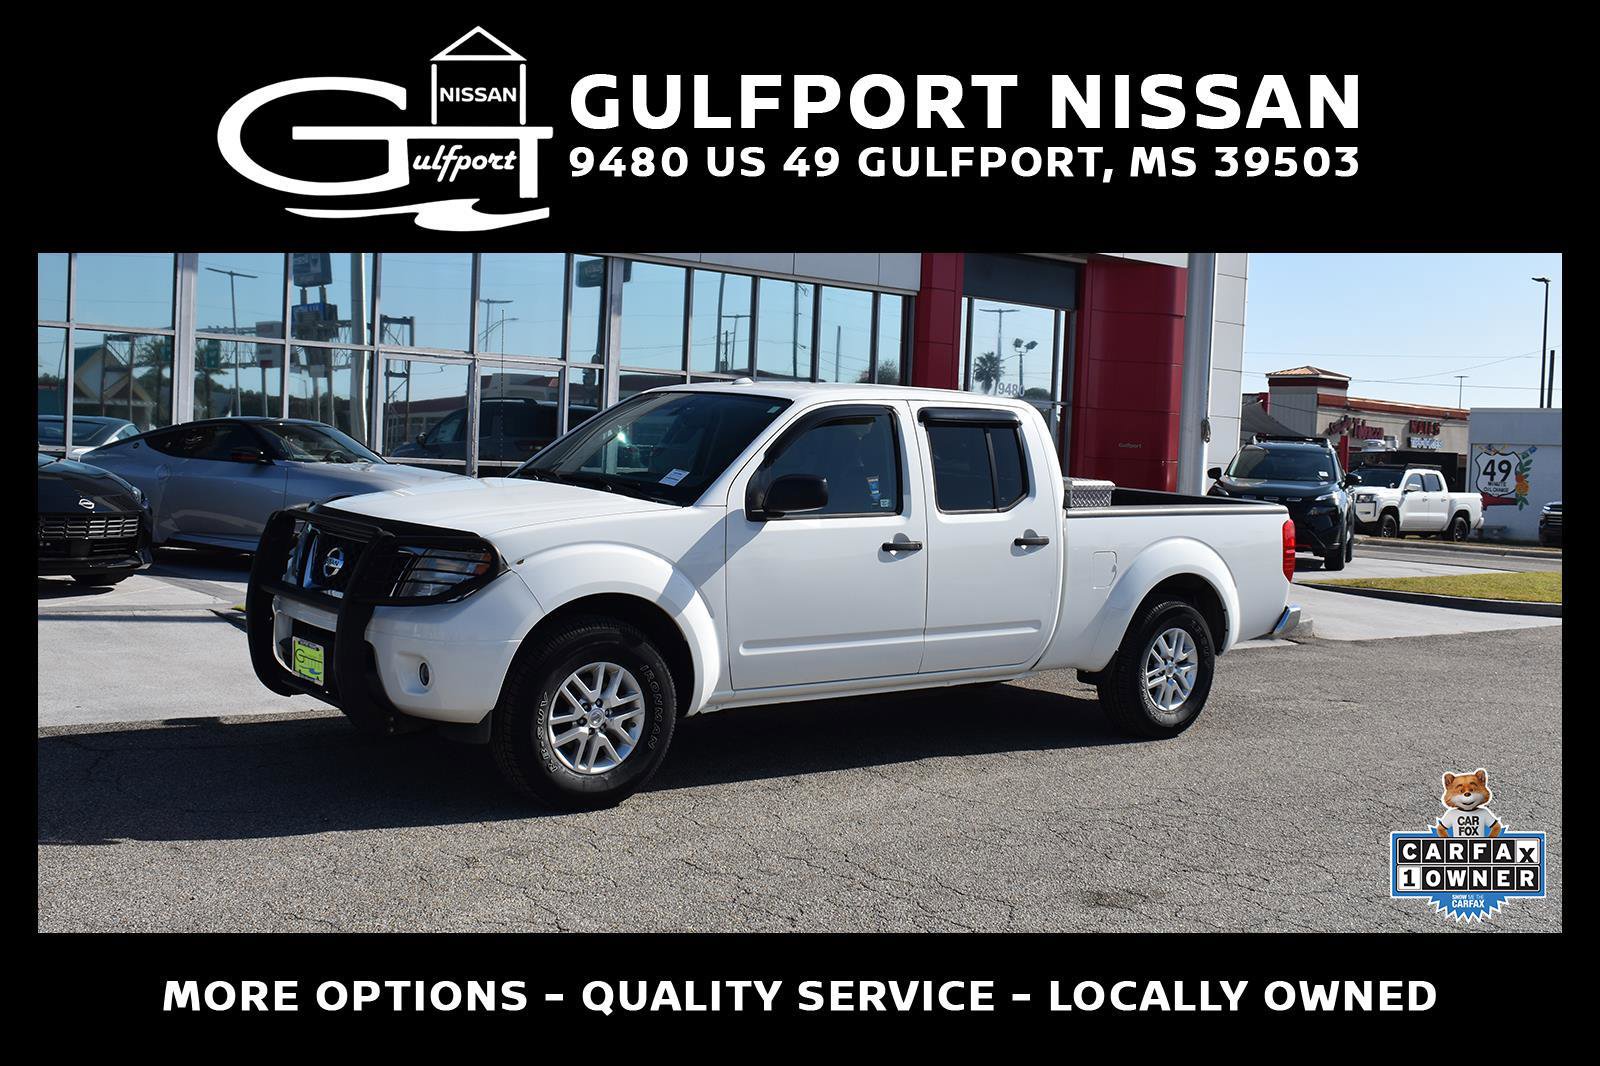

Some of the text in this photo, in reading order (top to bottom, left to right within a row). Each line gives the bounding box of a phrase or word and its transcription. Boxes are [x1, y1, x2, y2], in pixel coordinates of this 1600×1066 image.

[998, 383, 1024, 396] 9480
[1409, 420, 1440, 436] NAILS
[1482, 460, 1512, 482] 49
[640, 664, 664, 751] IRONMAN
